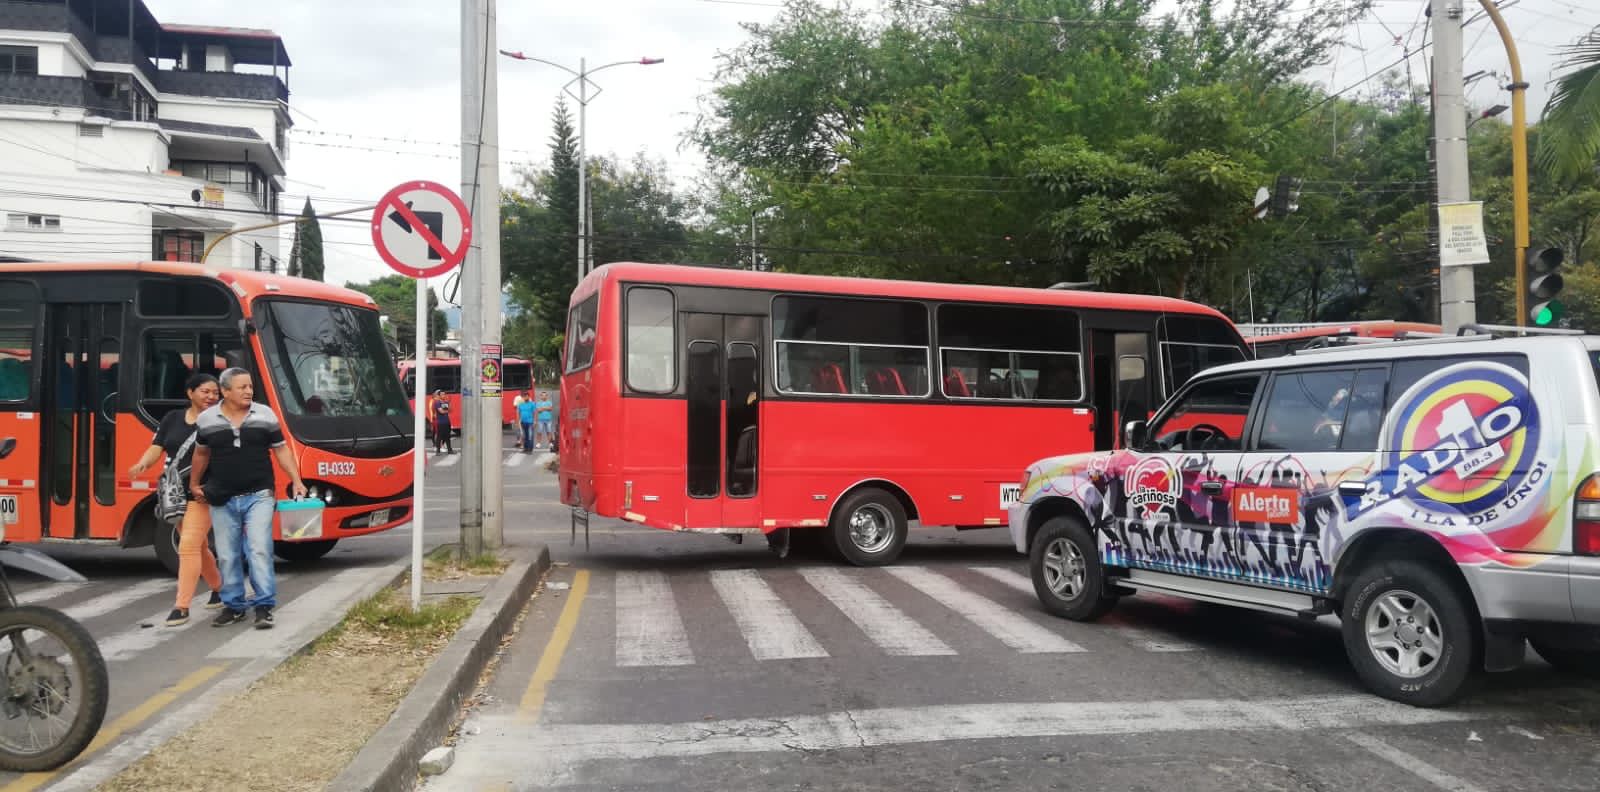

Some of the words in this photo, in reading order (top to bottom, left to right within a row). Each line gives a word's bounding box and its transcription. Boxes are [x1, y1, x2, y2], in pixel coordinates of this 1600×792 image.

[1359, 405, 1522, 512] RADIO
[317, 462, 356, 477] EI-0332
[0, 498, 15, 514] 00
[1132, 490, 1175, 505] cariñosa
[1239, 491, 1290, 512] Alerta
[1468, 508, 1499, 526] DE
